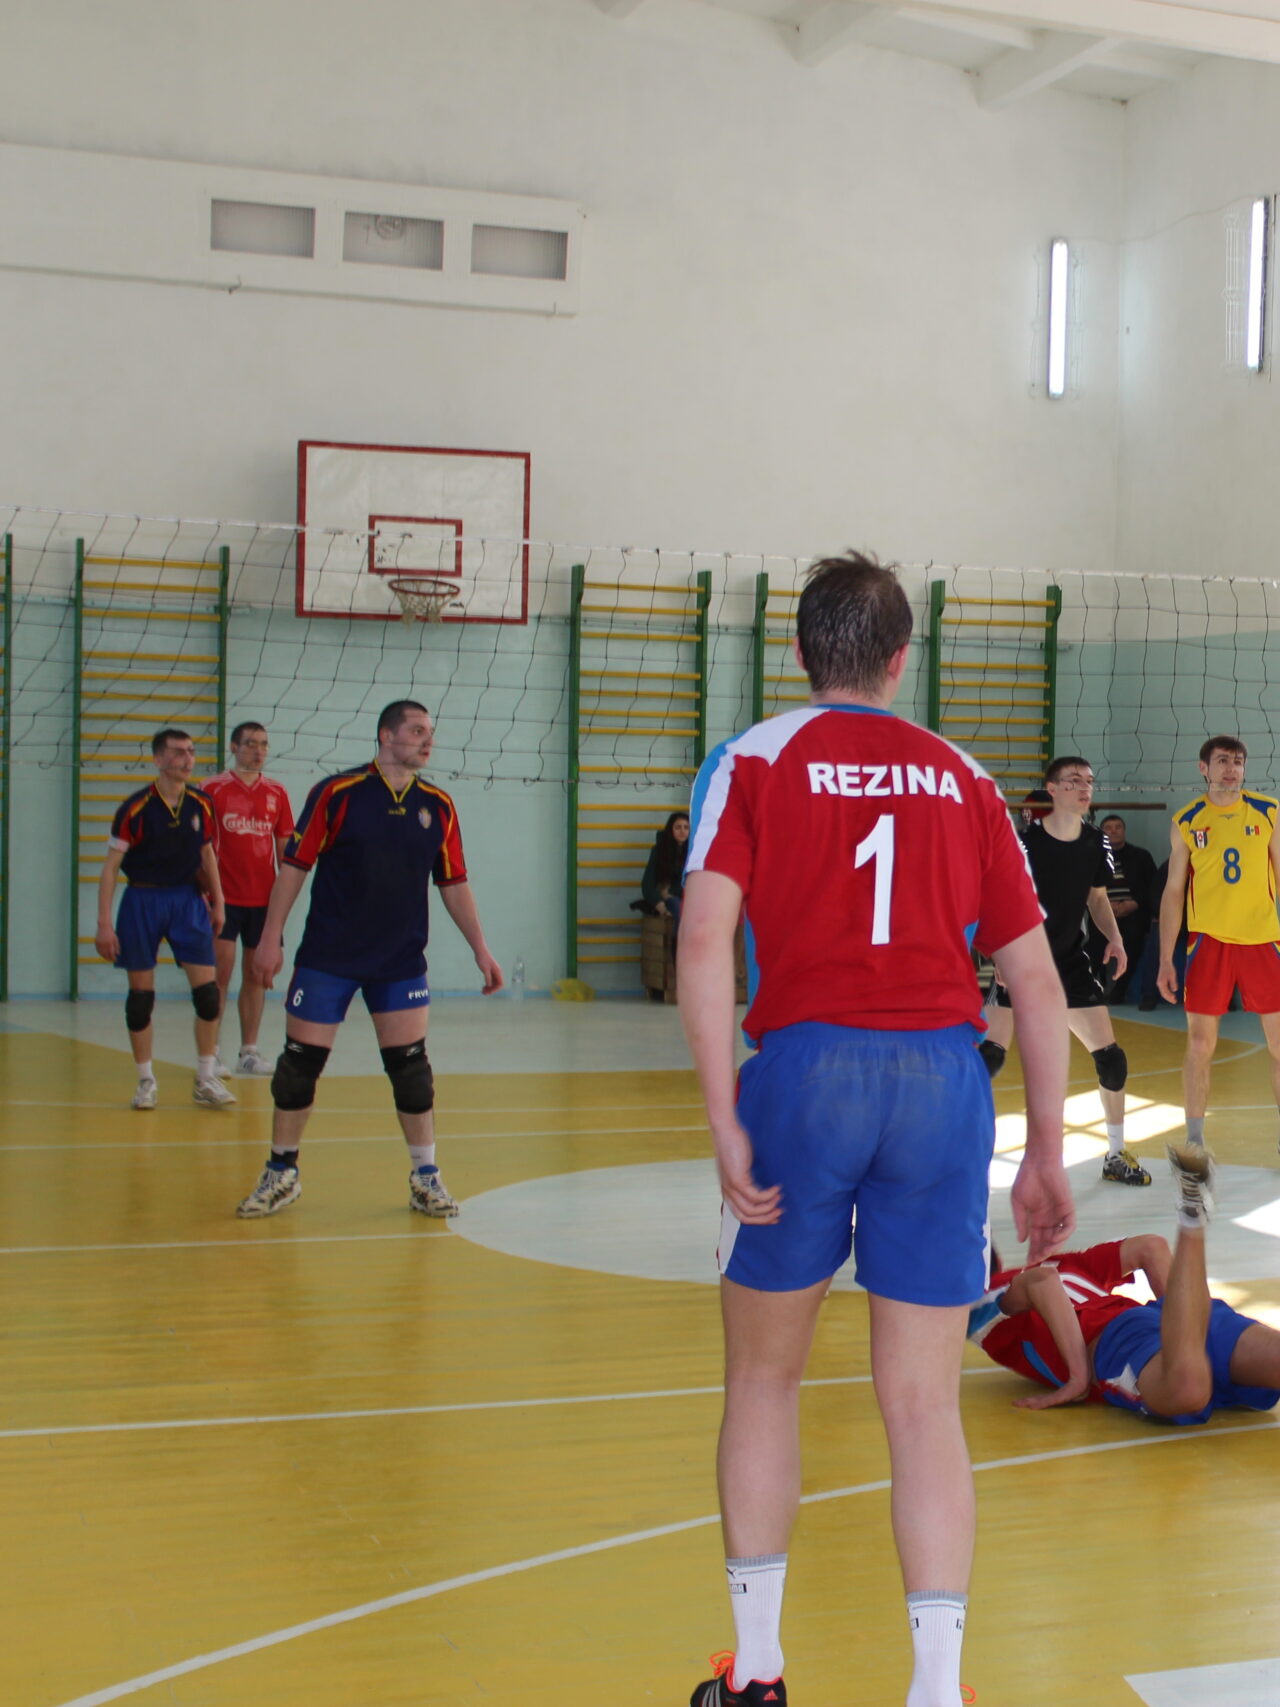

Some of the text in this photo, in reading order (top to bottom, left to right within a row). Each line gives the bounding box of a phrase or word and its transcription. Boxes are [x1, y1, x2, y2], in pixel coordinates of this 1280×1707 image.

[807, 763, 963, 804] REZINA
[854, 814, 894, 945] 1
[1223, 847, 1241, 885] 8
[292, 989, 304, 1007] 6
